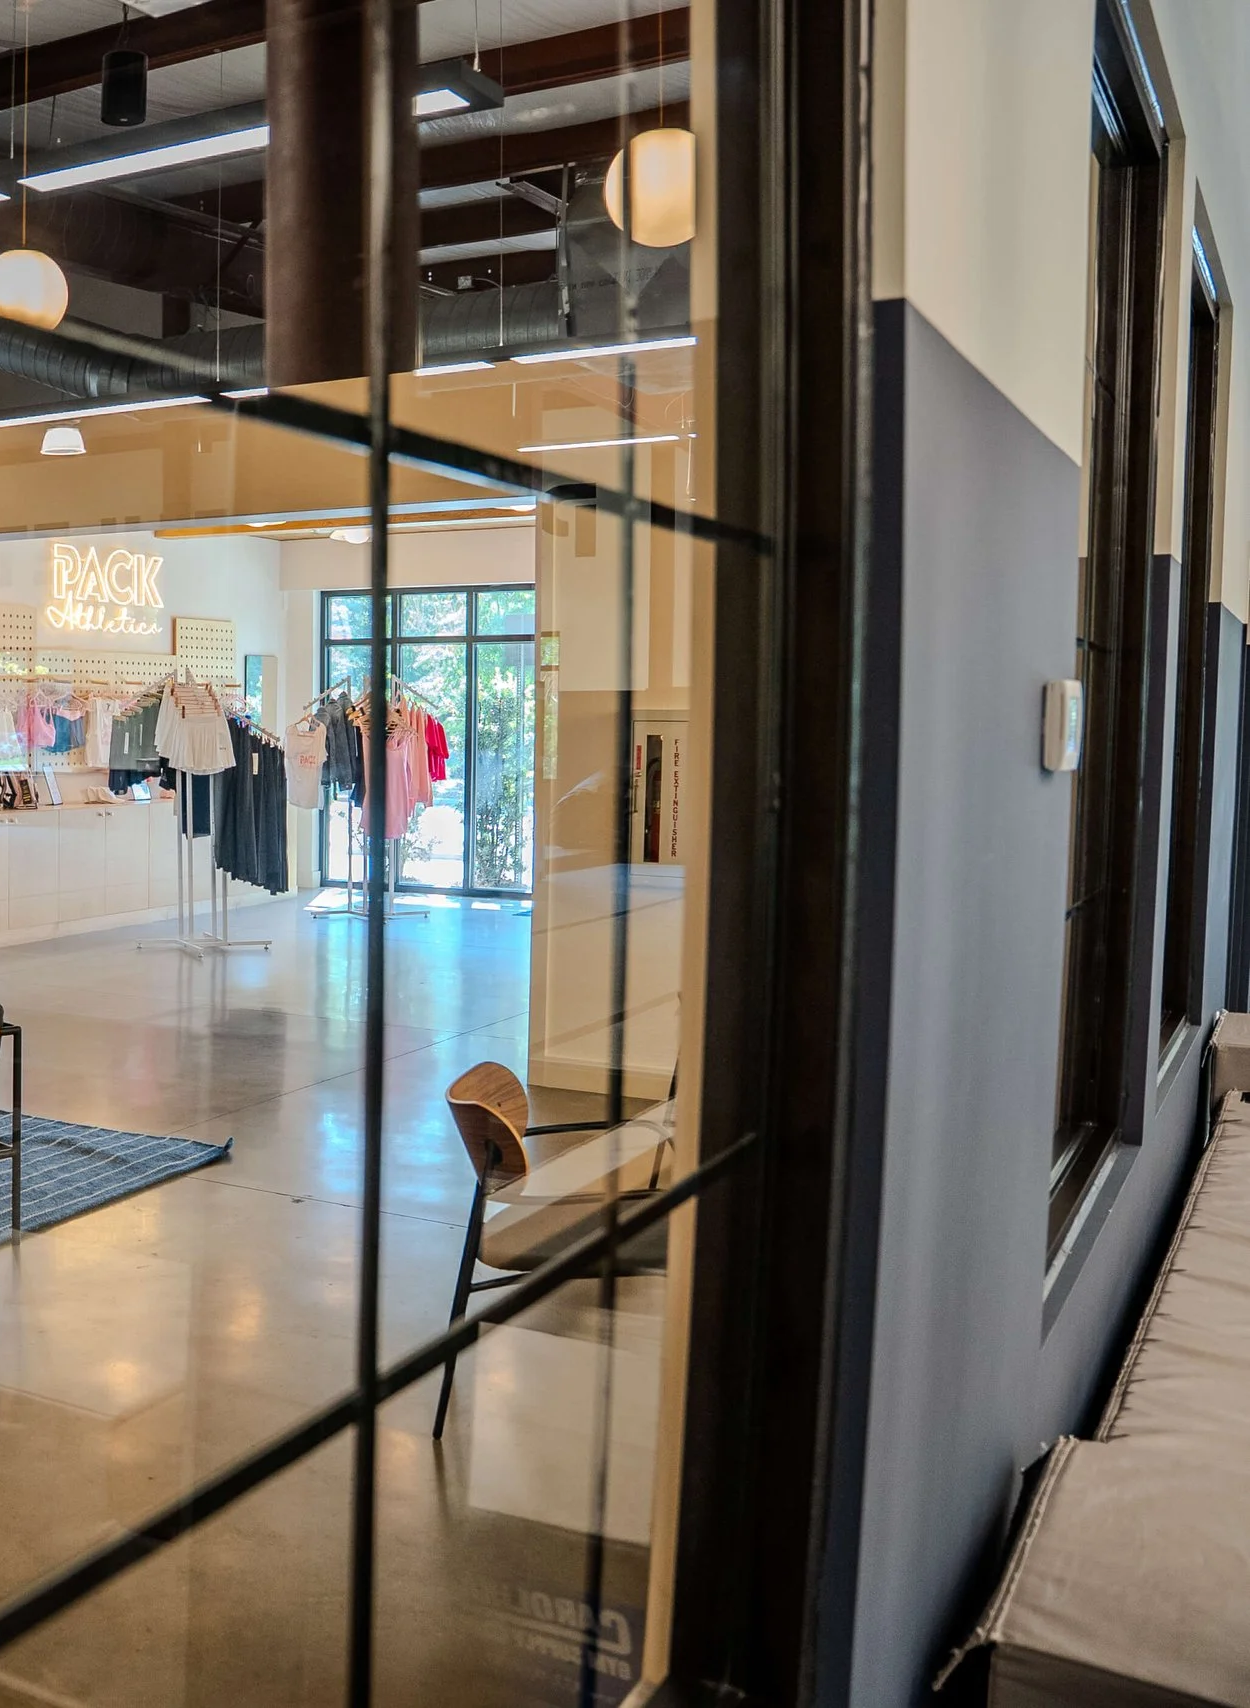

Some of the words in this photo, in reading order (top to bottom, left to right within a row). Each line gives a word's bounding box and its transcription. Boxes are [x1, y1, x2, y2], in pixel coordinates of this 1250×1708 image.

[53, 543, 164, 609] PACK
[46, 591, 163, 635] Athletics
[671, 771, 679, 857] EXTINGUISHER
